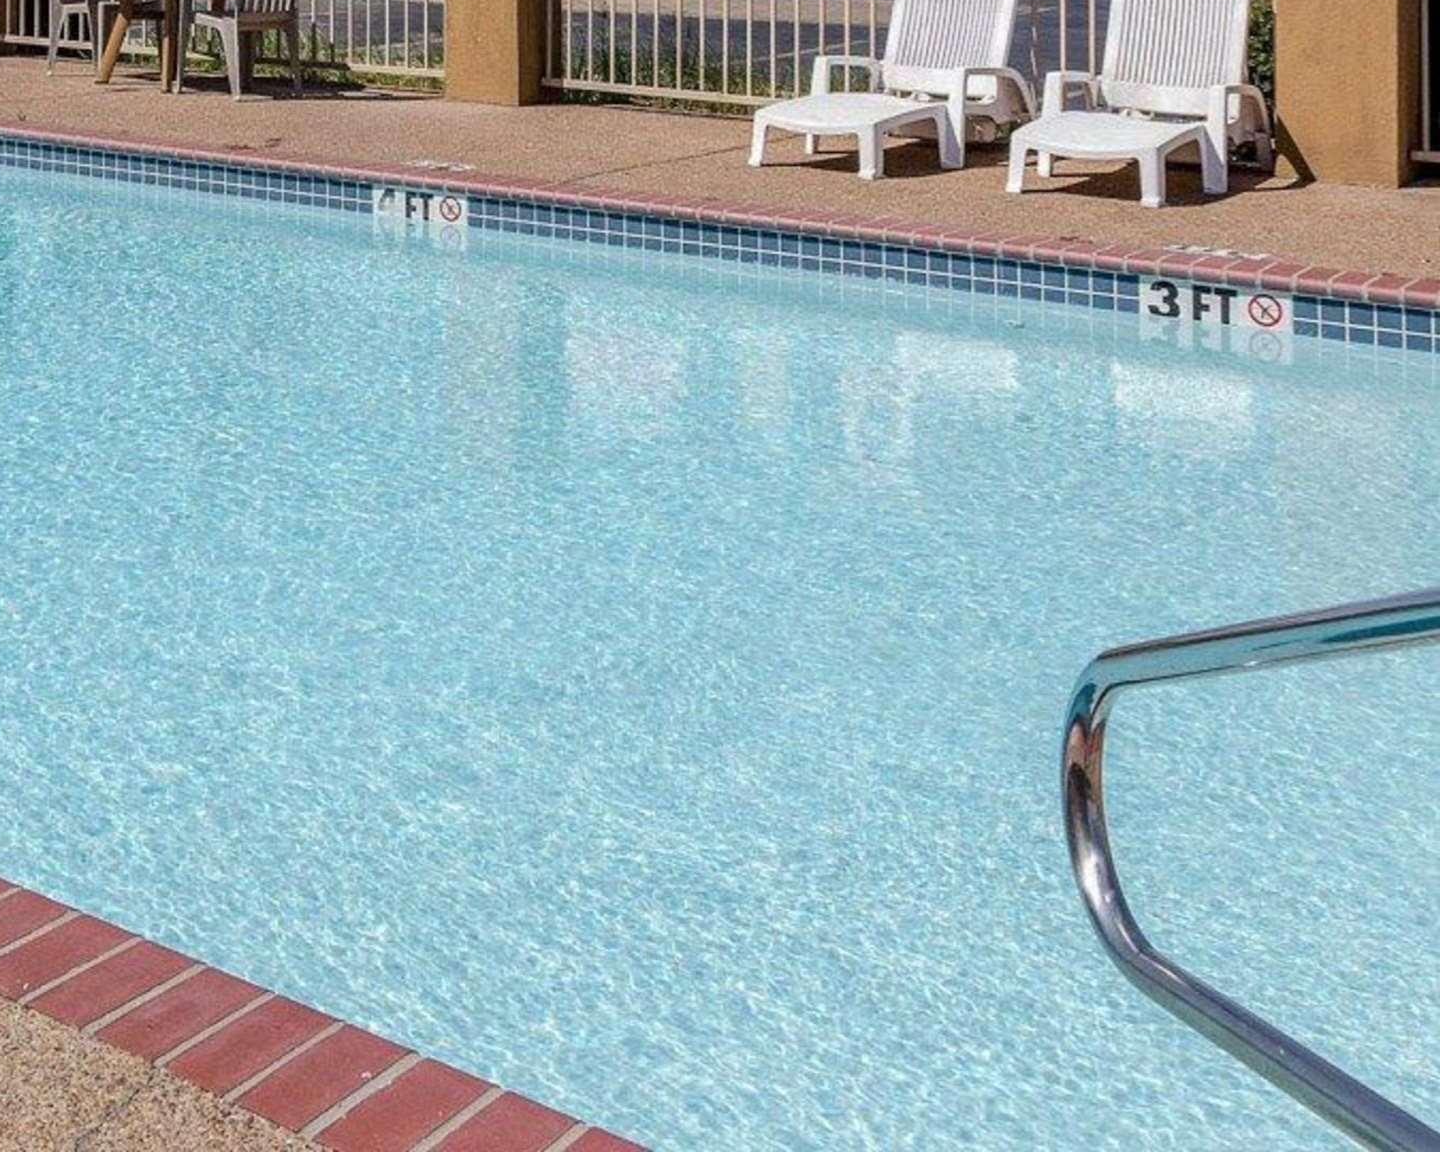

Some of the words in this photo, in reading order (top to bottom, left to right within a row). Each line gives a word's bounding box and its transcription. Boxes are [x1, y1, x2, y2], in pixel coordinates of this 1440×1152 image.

[405, 191, 434, 221] FT
[1147, 281, 1181, 318] 3
[1193, 285, 1238, 324] FT
